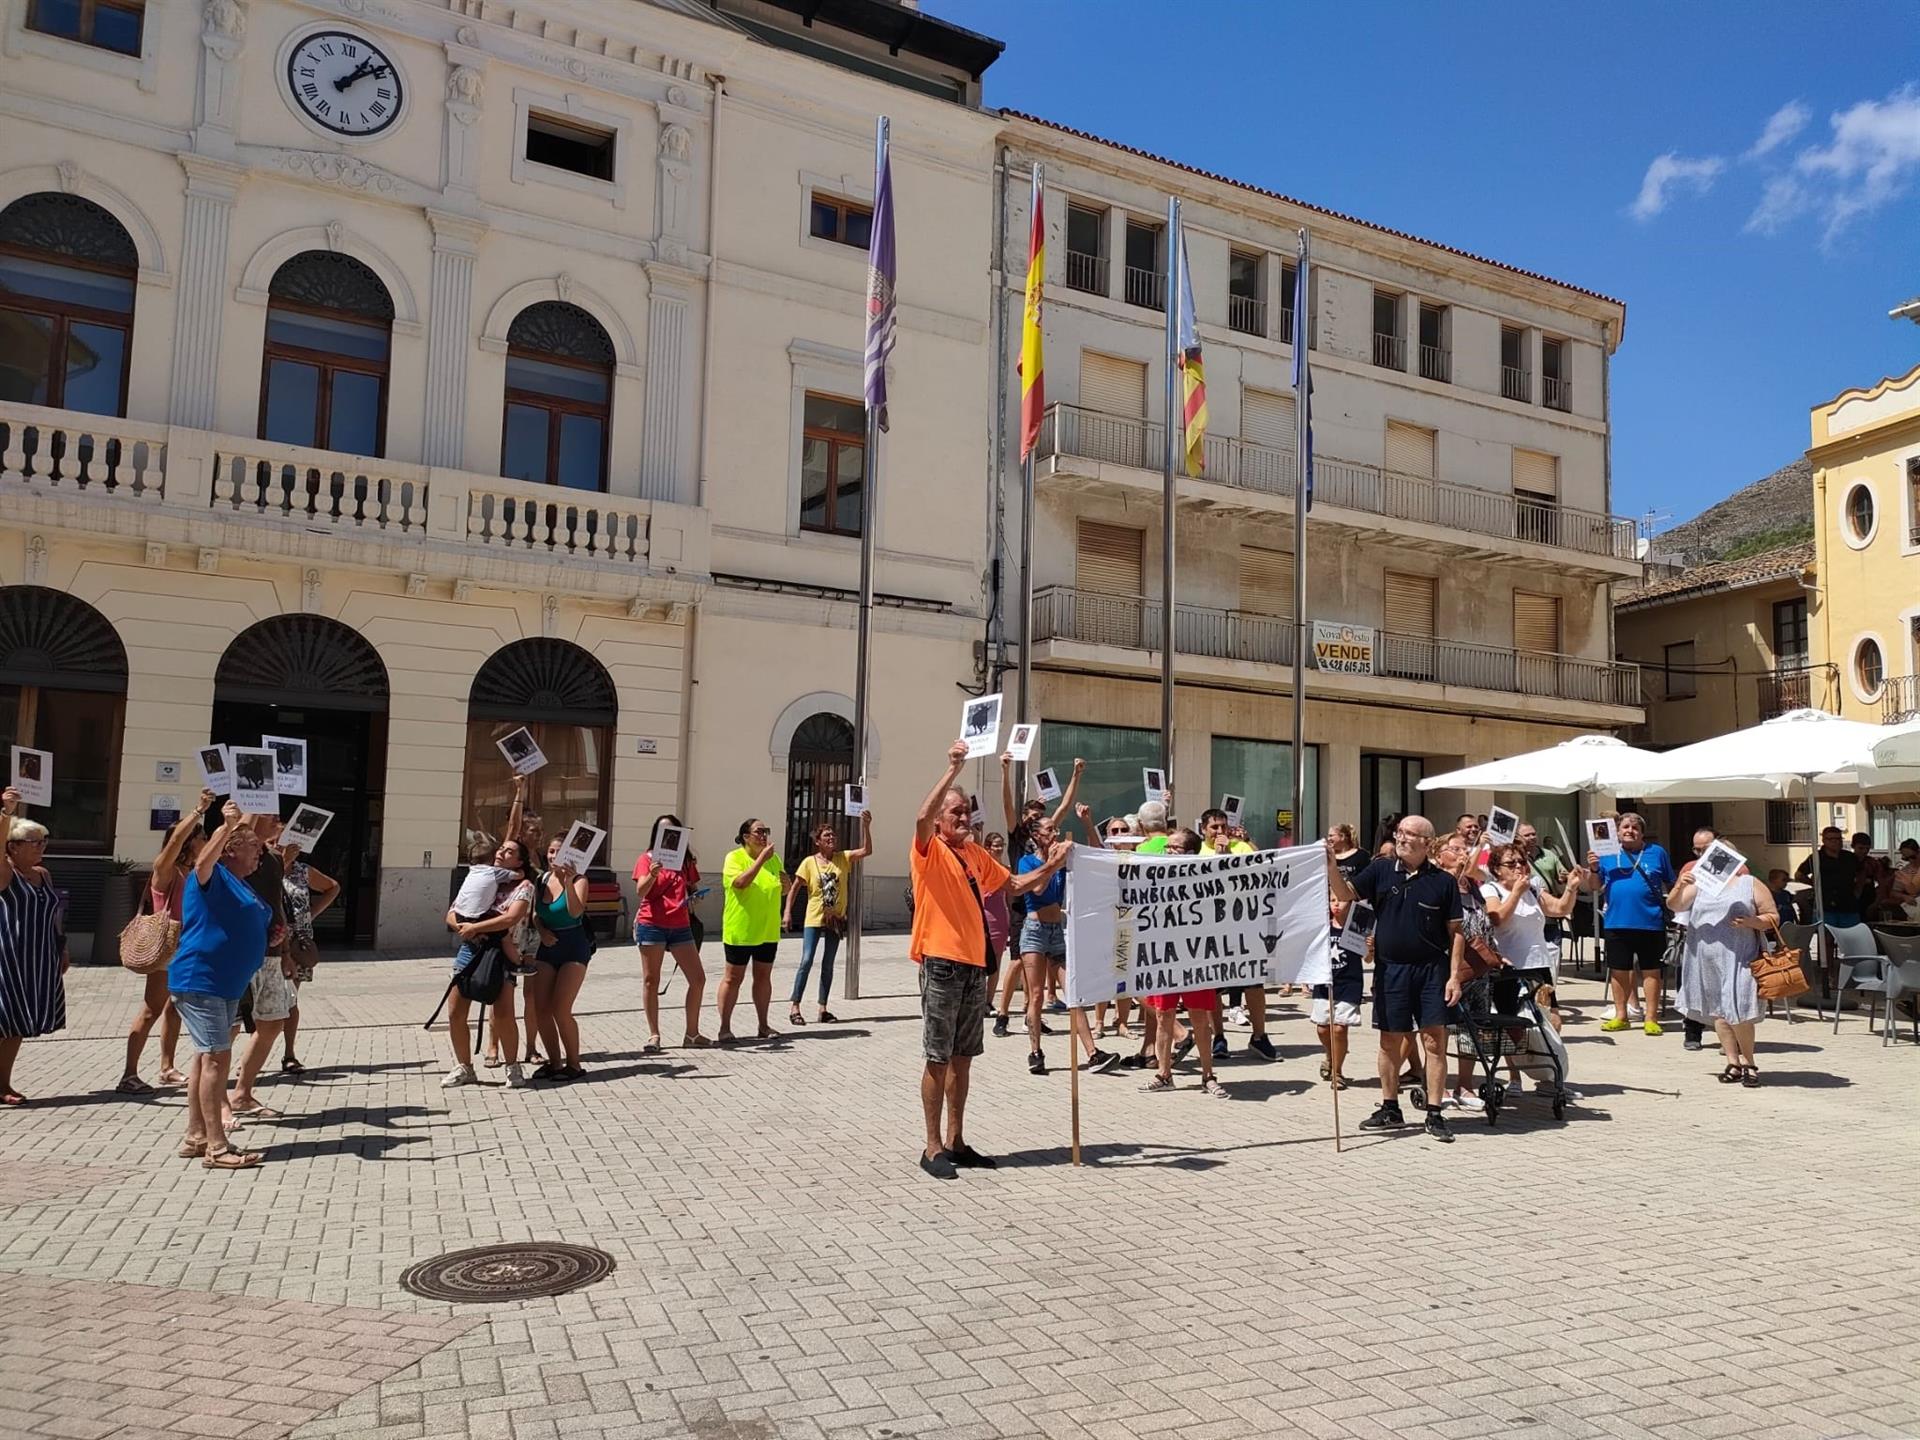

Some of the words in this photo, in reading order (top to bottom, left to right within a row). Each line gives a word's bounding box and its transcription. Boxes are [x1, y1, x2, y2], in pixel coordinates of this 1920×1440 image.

[1317, 643, 1370, 660] VENDE
[1118, 863, 1140, 880] UN
[1218, 857, 1241, 871] NO
[1245, 852, 1276, 866] POT
[1122, 884, 1190, 905] CAMBIAR
[1193, 878, 1225, 899] UNA
[1214, 893, 1276, 923] BOUS
[1186, 933, 1250, 960] VALL
[1135, 971, 1153, 991] NO
[1157, 969, 1178, 988] AL
[1183, 959, 1269, 987] MALTRACTE
